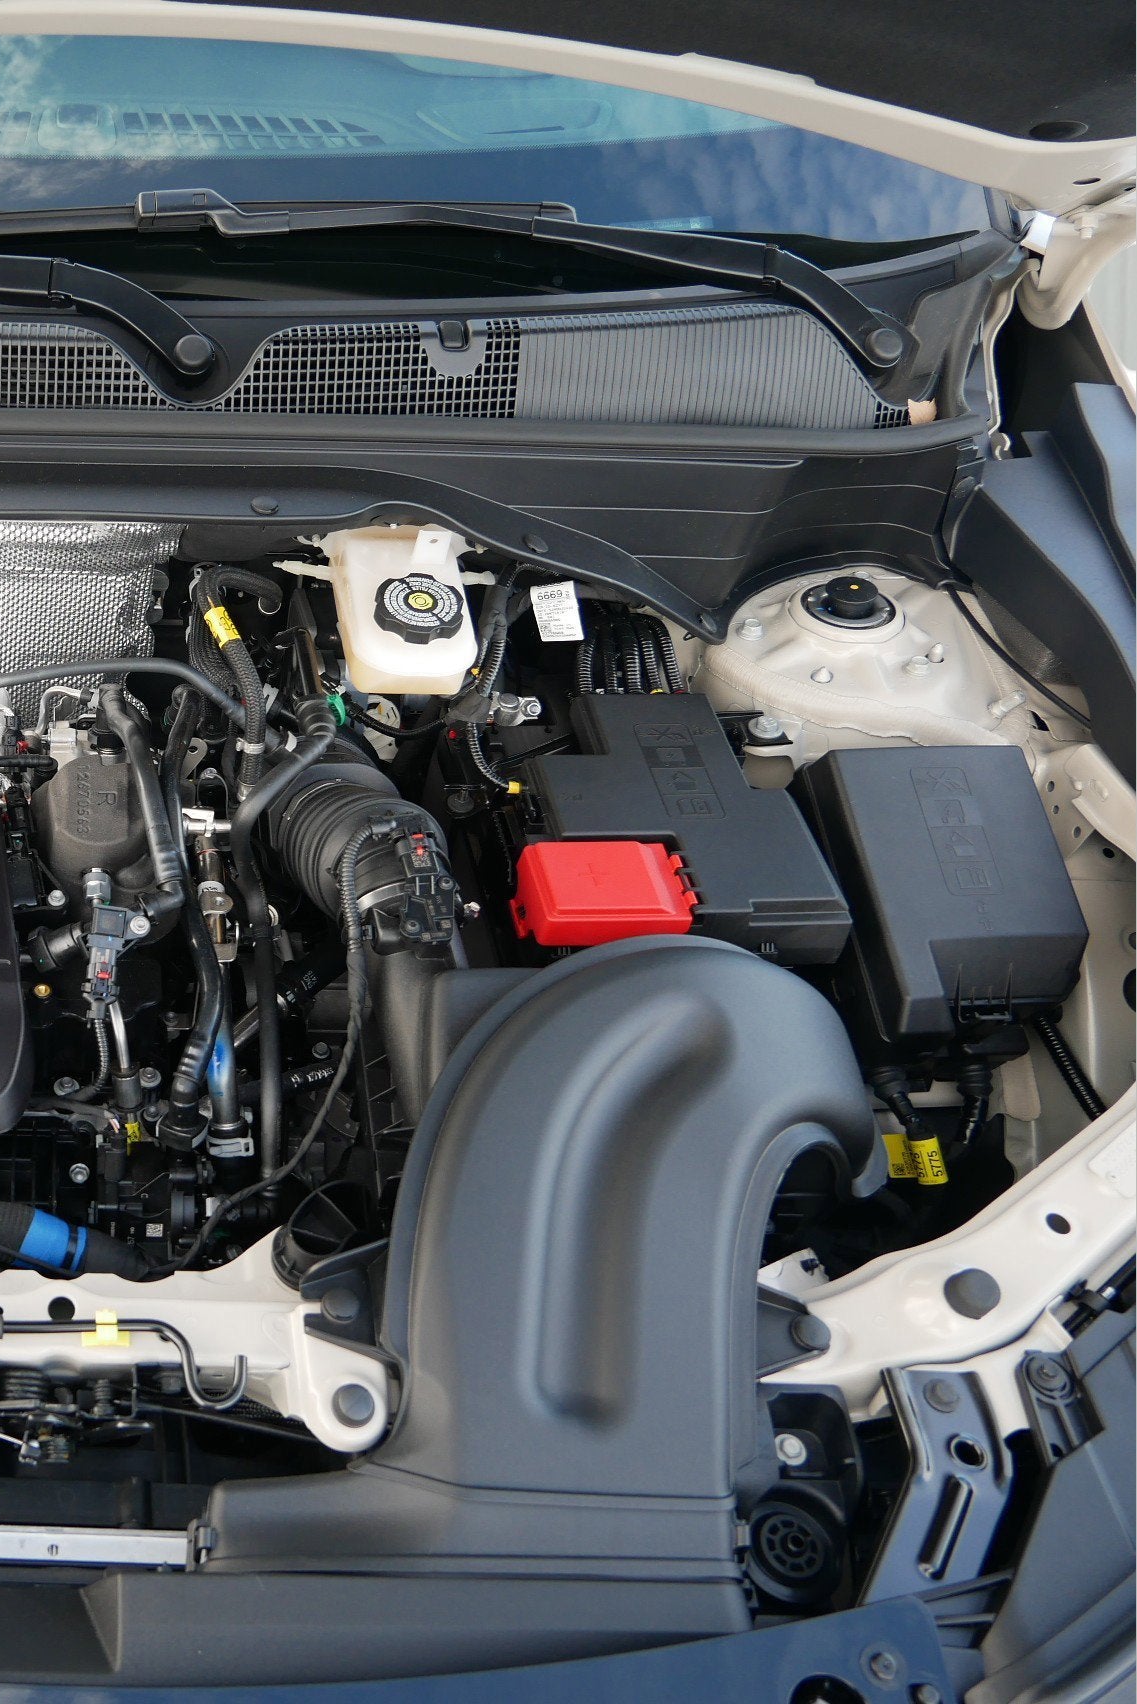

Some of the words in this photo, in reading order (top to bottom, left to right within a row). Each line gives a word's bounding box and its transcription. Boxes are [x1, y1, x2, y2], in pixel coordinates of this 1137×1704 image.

[537, 590, 563, 600] 6669
[97, 790, 118, 806] R
[927, 1150, 943, 1177] 5775
